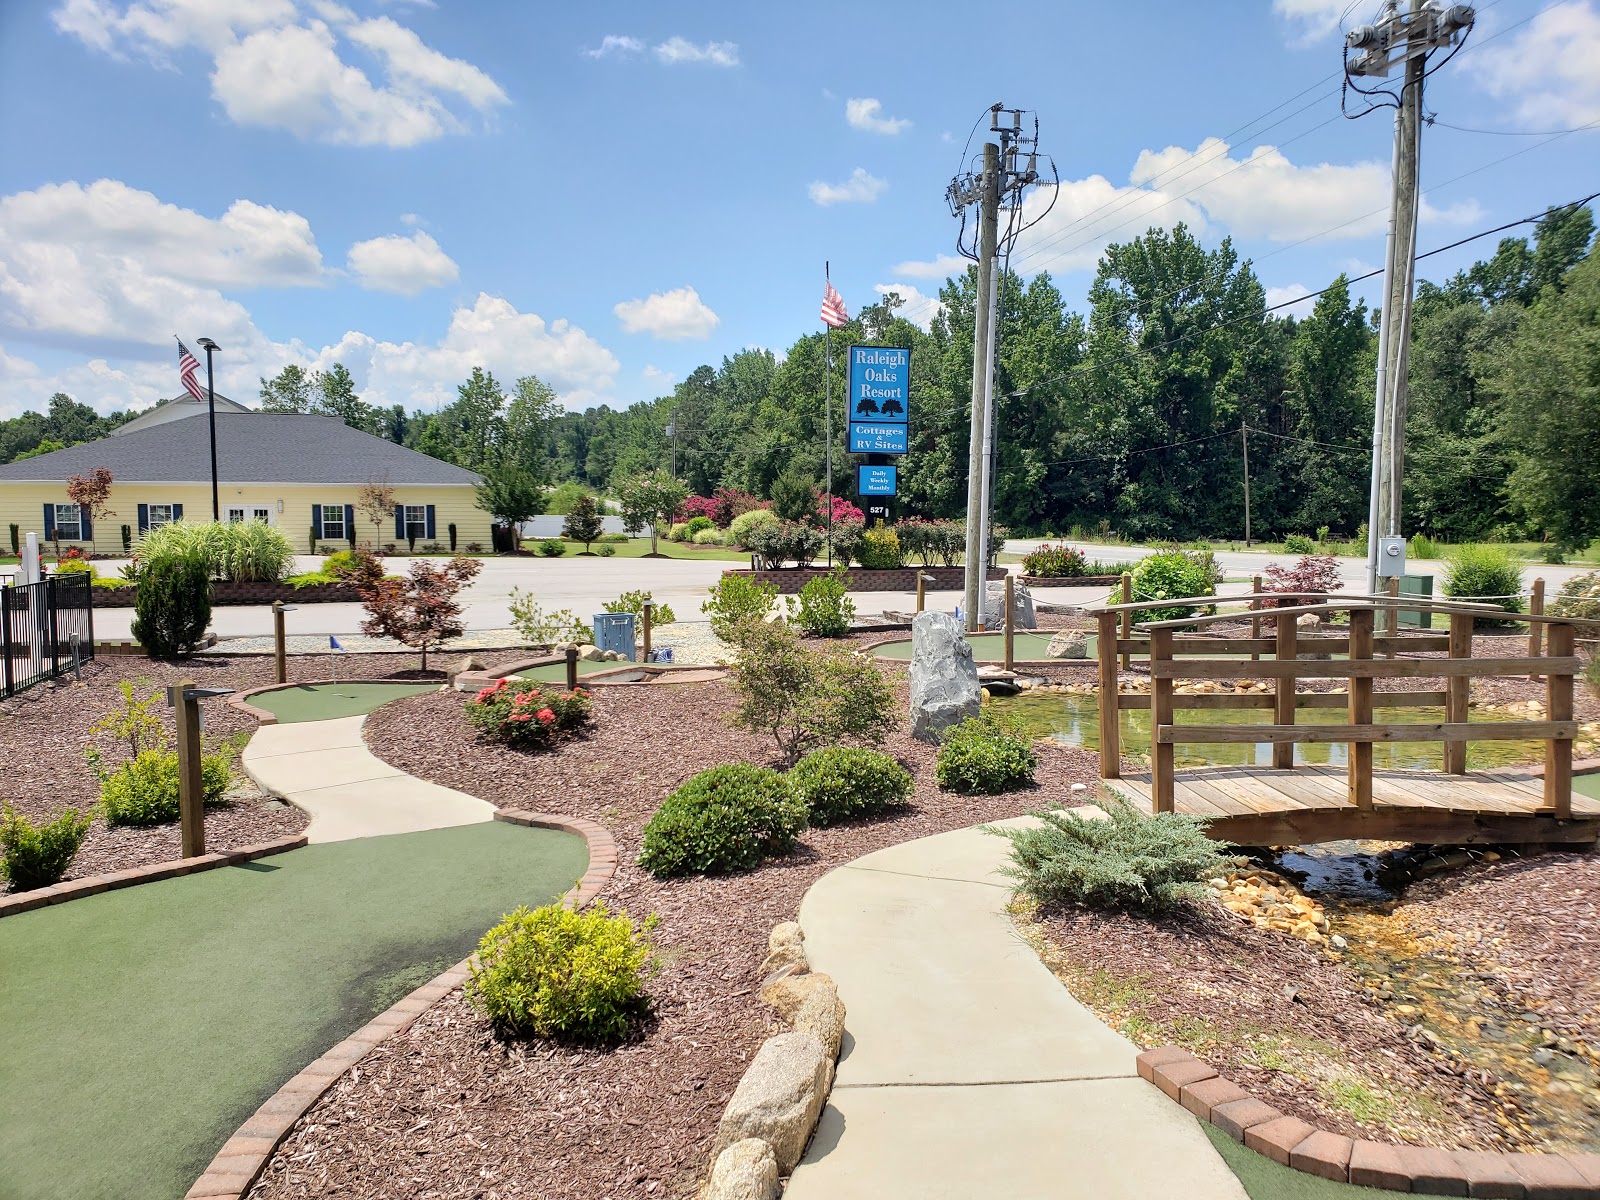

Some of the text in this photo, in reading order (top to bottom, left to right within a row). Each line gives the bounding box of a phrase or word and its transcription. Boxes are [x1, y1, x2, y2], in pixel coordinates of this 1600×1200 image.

[856, 350, 906, 369] Raleigh
[865, 368, 897, 382] Oaks
[861, 384, 901, 398] Resort
[856, 426, 903, 437] Cottages
[857, 440, 903, 449] RV Sites
